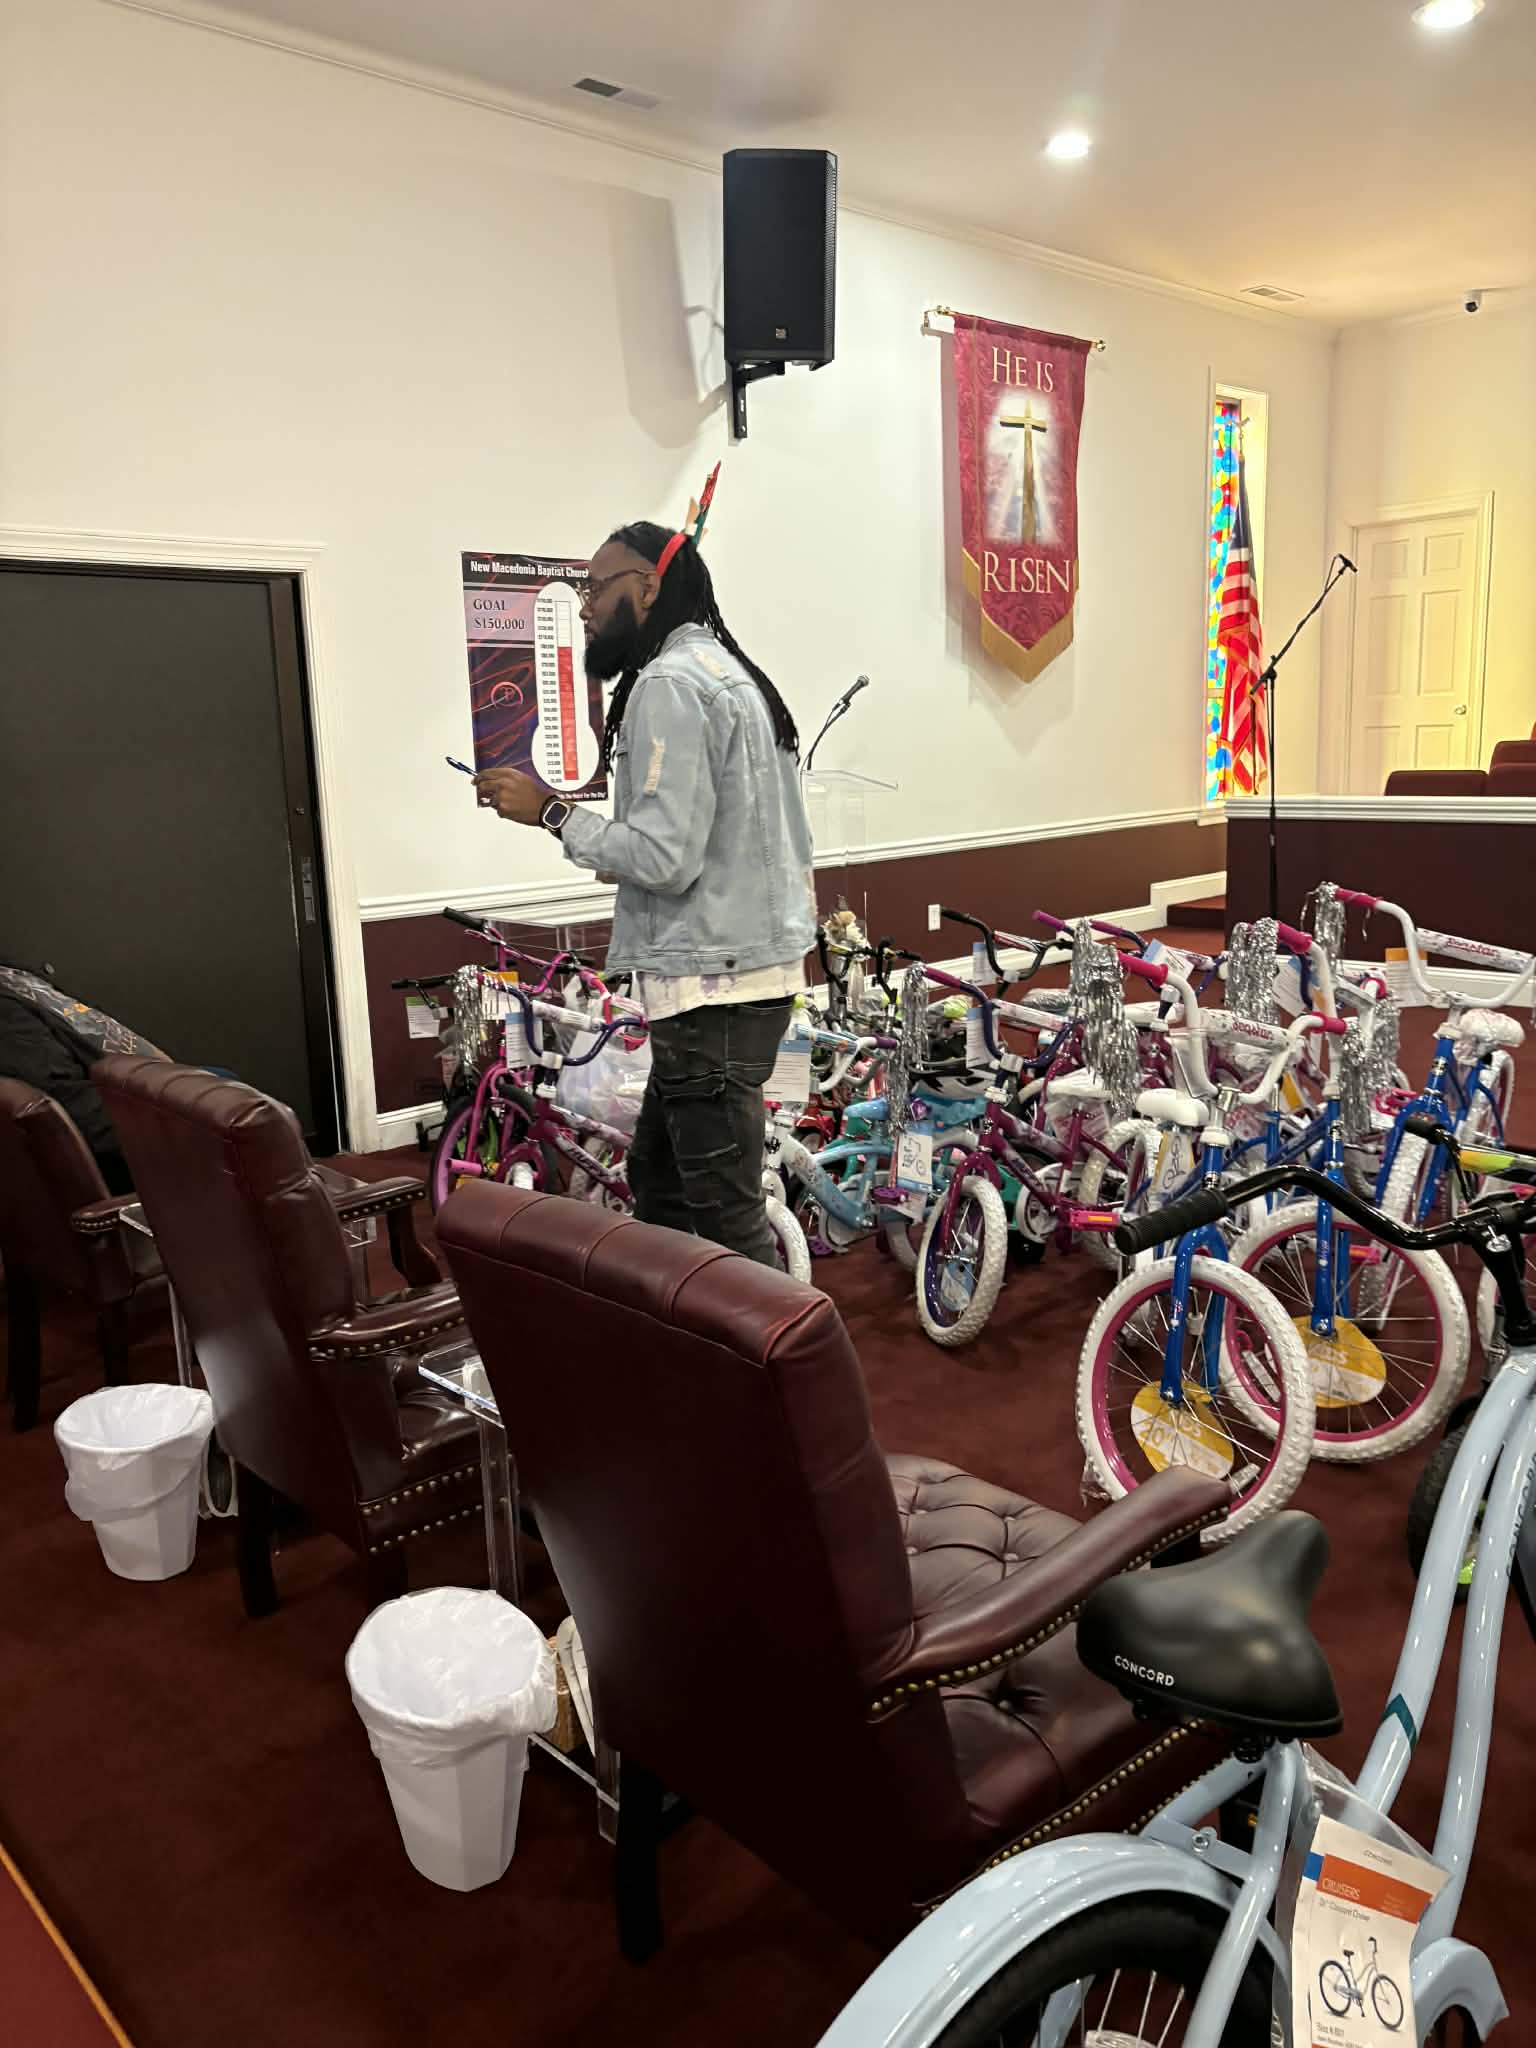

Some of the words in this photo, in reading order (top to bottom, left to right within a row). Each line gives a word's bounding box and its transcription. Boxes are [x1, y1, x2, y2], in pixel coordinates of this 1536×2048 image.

[992, 347, 1028, 387] HE
[1036, 361, 1054, 392] IS
[470, 560, 490, 573] New
[492, 562, 536, 575] Macedonia
[538, 566, 565, 577] Baptist
[983, 551, 1071, 593] RISEN
[473, 598, 507, 611] GOAL
[473, 617, 525, 630] $150,000
[1114, 1655, 1175, 1687] CONCORD
